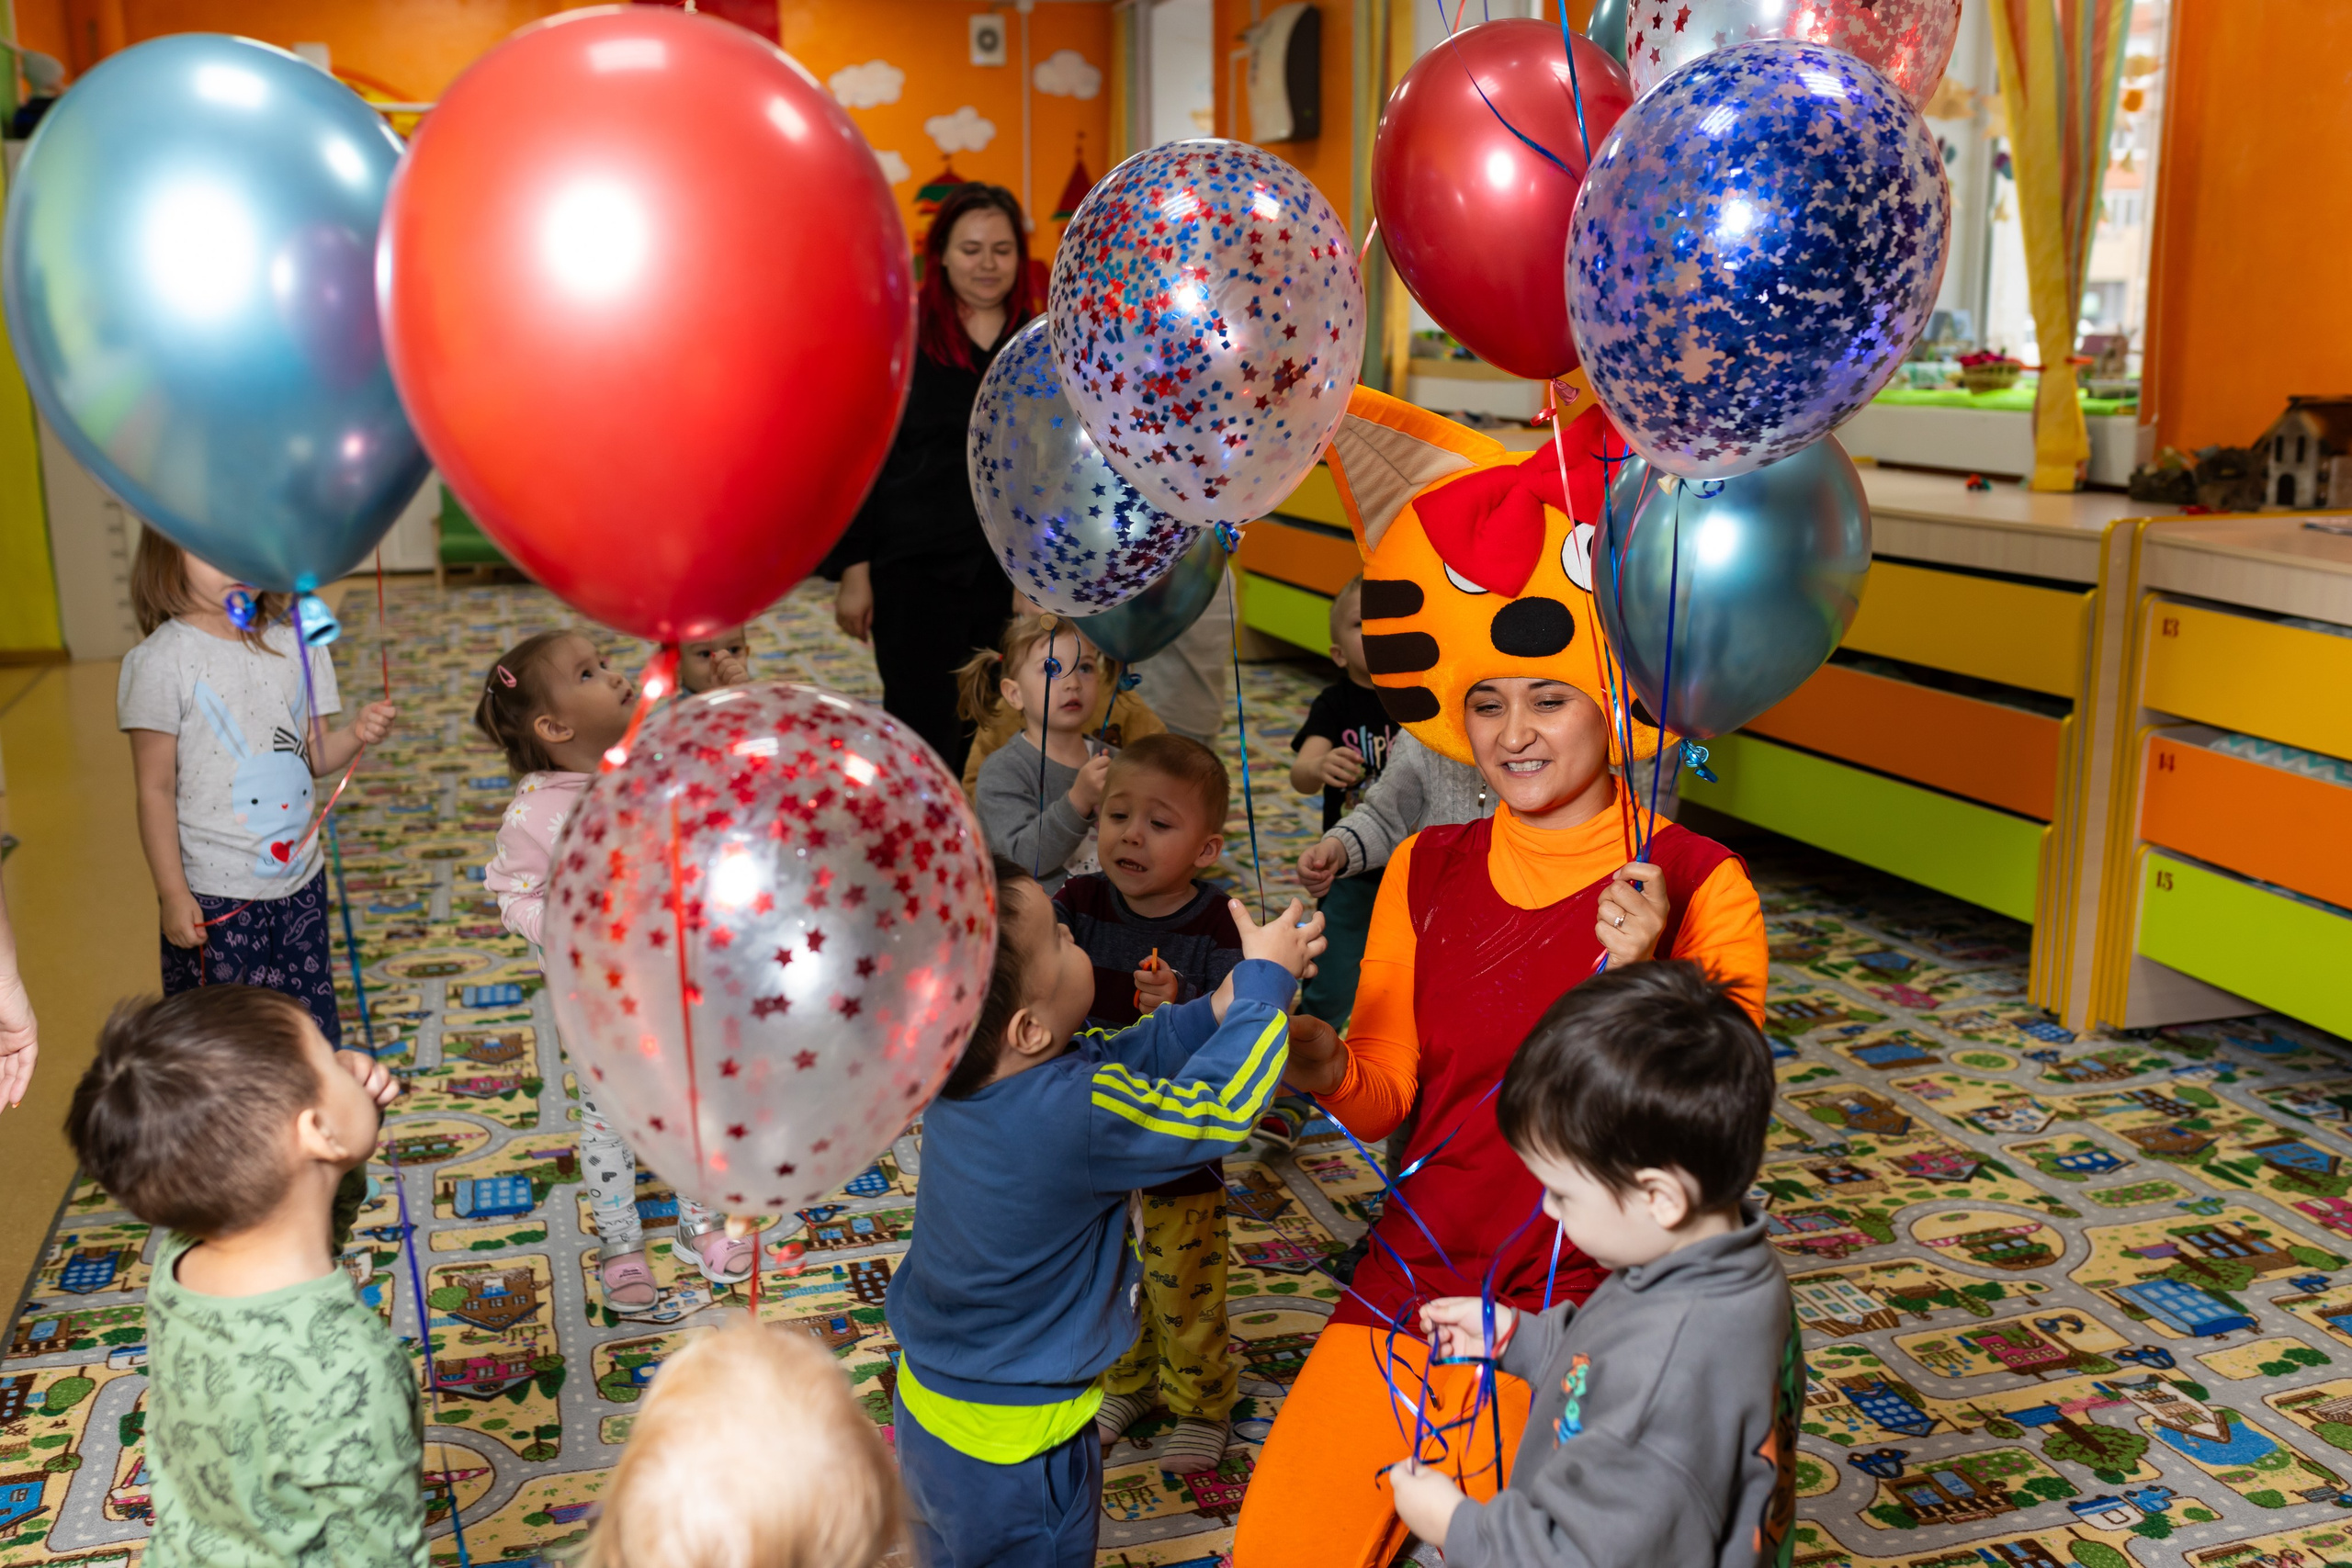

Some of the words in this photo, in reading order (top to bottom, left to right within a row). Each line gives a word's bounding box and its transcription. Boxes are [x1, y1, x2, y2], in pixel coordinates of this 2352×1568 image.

[2163, 617, 2179, 638] 13
[2159, 752, 2175, 773] 14
[2155, 870, 2173, 891] 15
